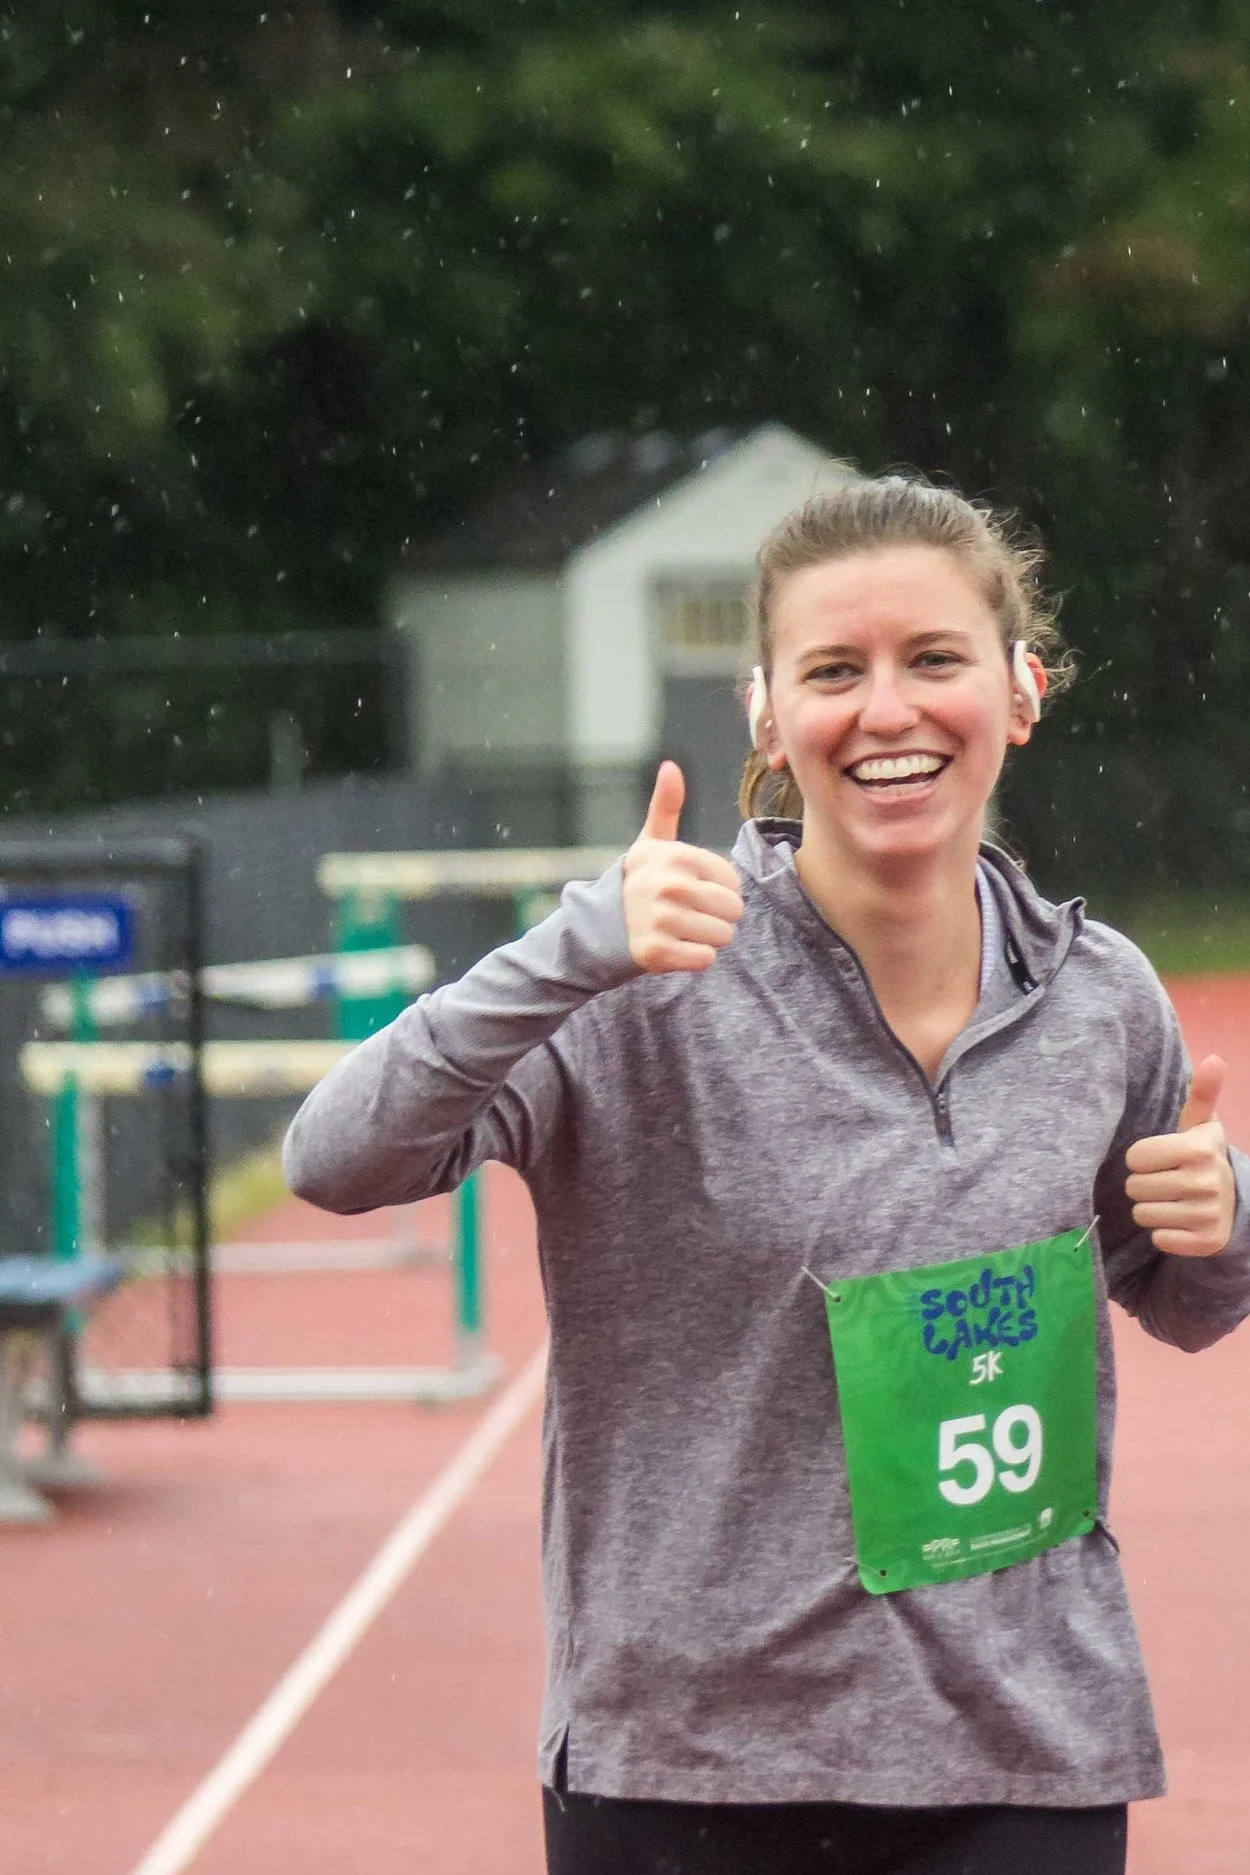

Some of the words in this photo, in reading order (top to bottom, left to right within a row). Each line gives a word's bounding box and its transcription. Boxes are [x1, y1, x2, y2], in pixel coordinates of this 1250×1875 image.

[921, 1265, 1035, 1320] SOUTH
[924, 1307, 1038, 1361] LAKES
[969, 1350, 1004, 1385] 5K
[938, 1404, 1043, 1505] 59
